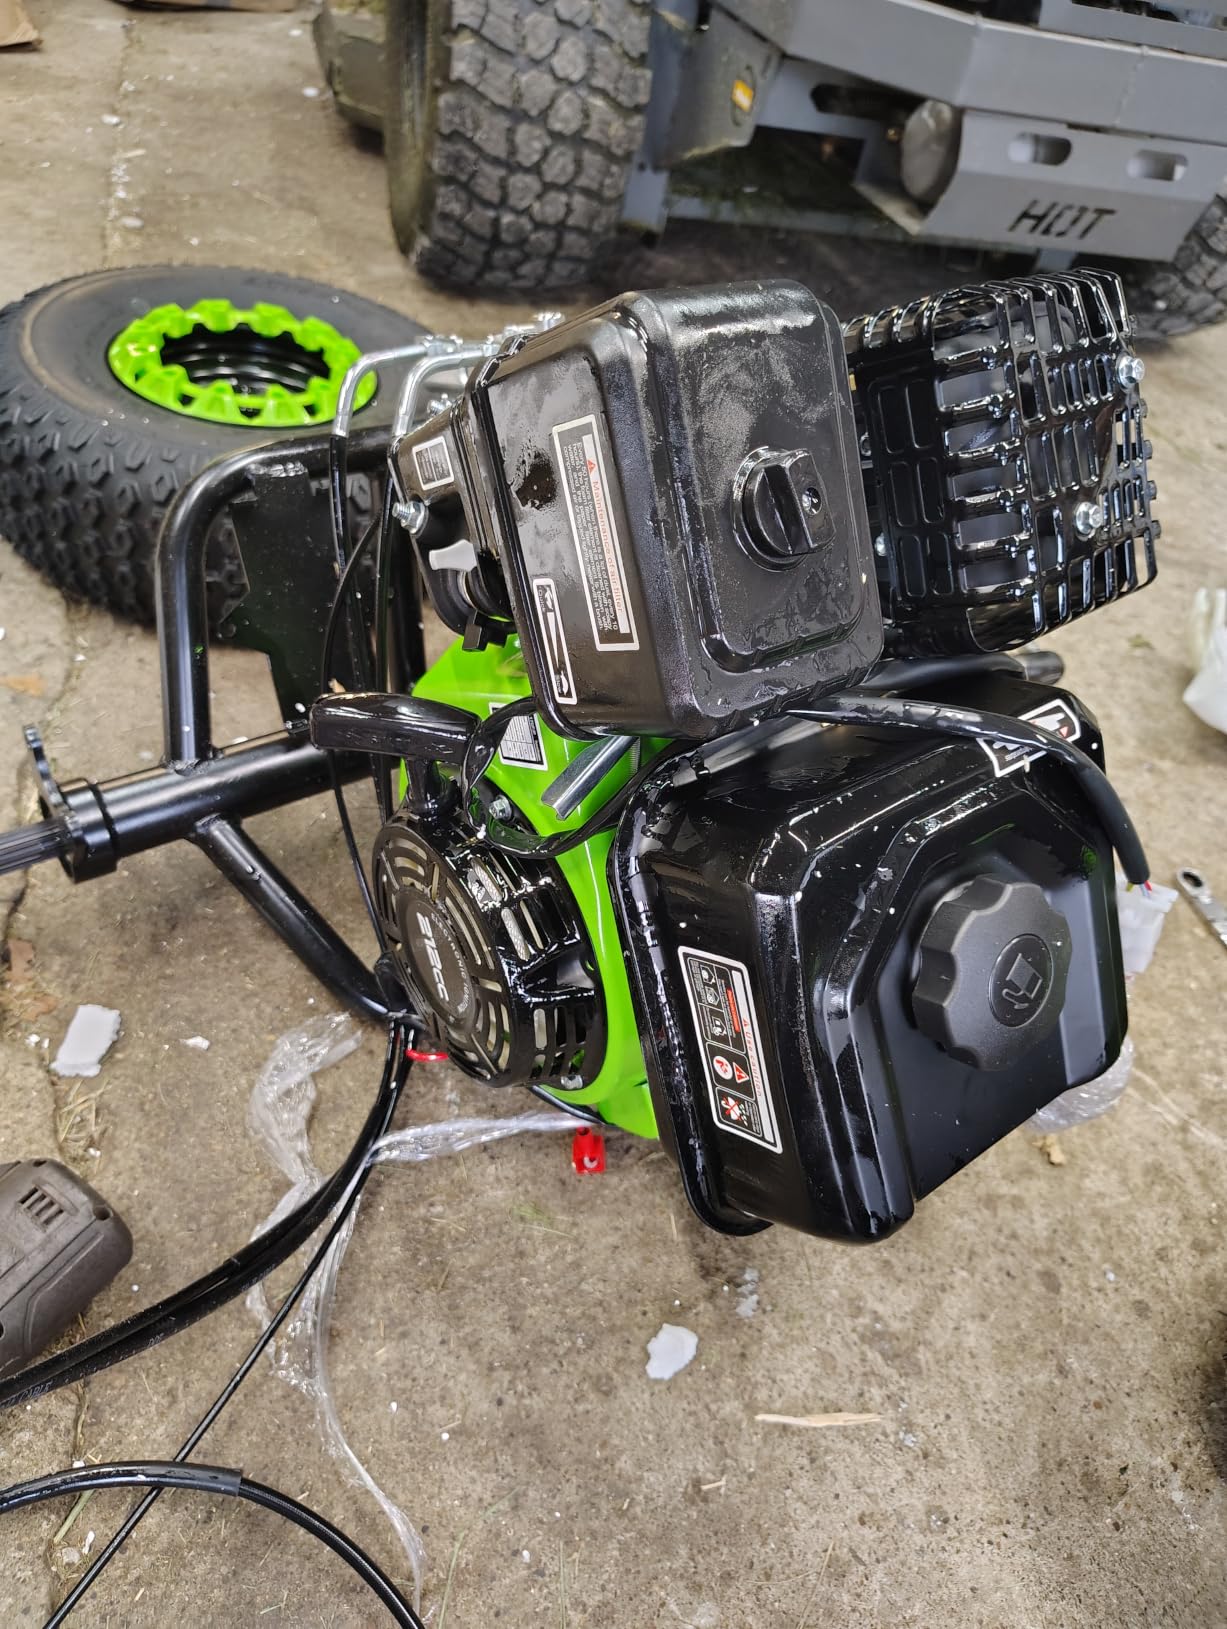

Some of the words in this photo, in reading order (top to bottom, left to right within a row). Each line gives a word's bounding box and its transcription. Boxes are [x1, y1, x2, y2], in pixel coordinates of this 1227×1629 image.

[1008, 200, 1117, 240] HOT
[591, 479, 612, 554] Maintenance
[606, 557, 615, 568] of
[609, 570, 618, 583] air
[612, 587, 623, 612] filter
[744, 1030, 754, 1052] Use
[749, 1054, 764, 1098] caution
